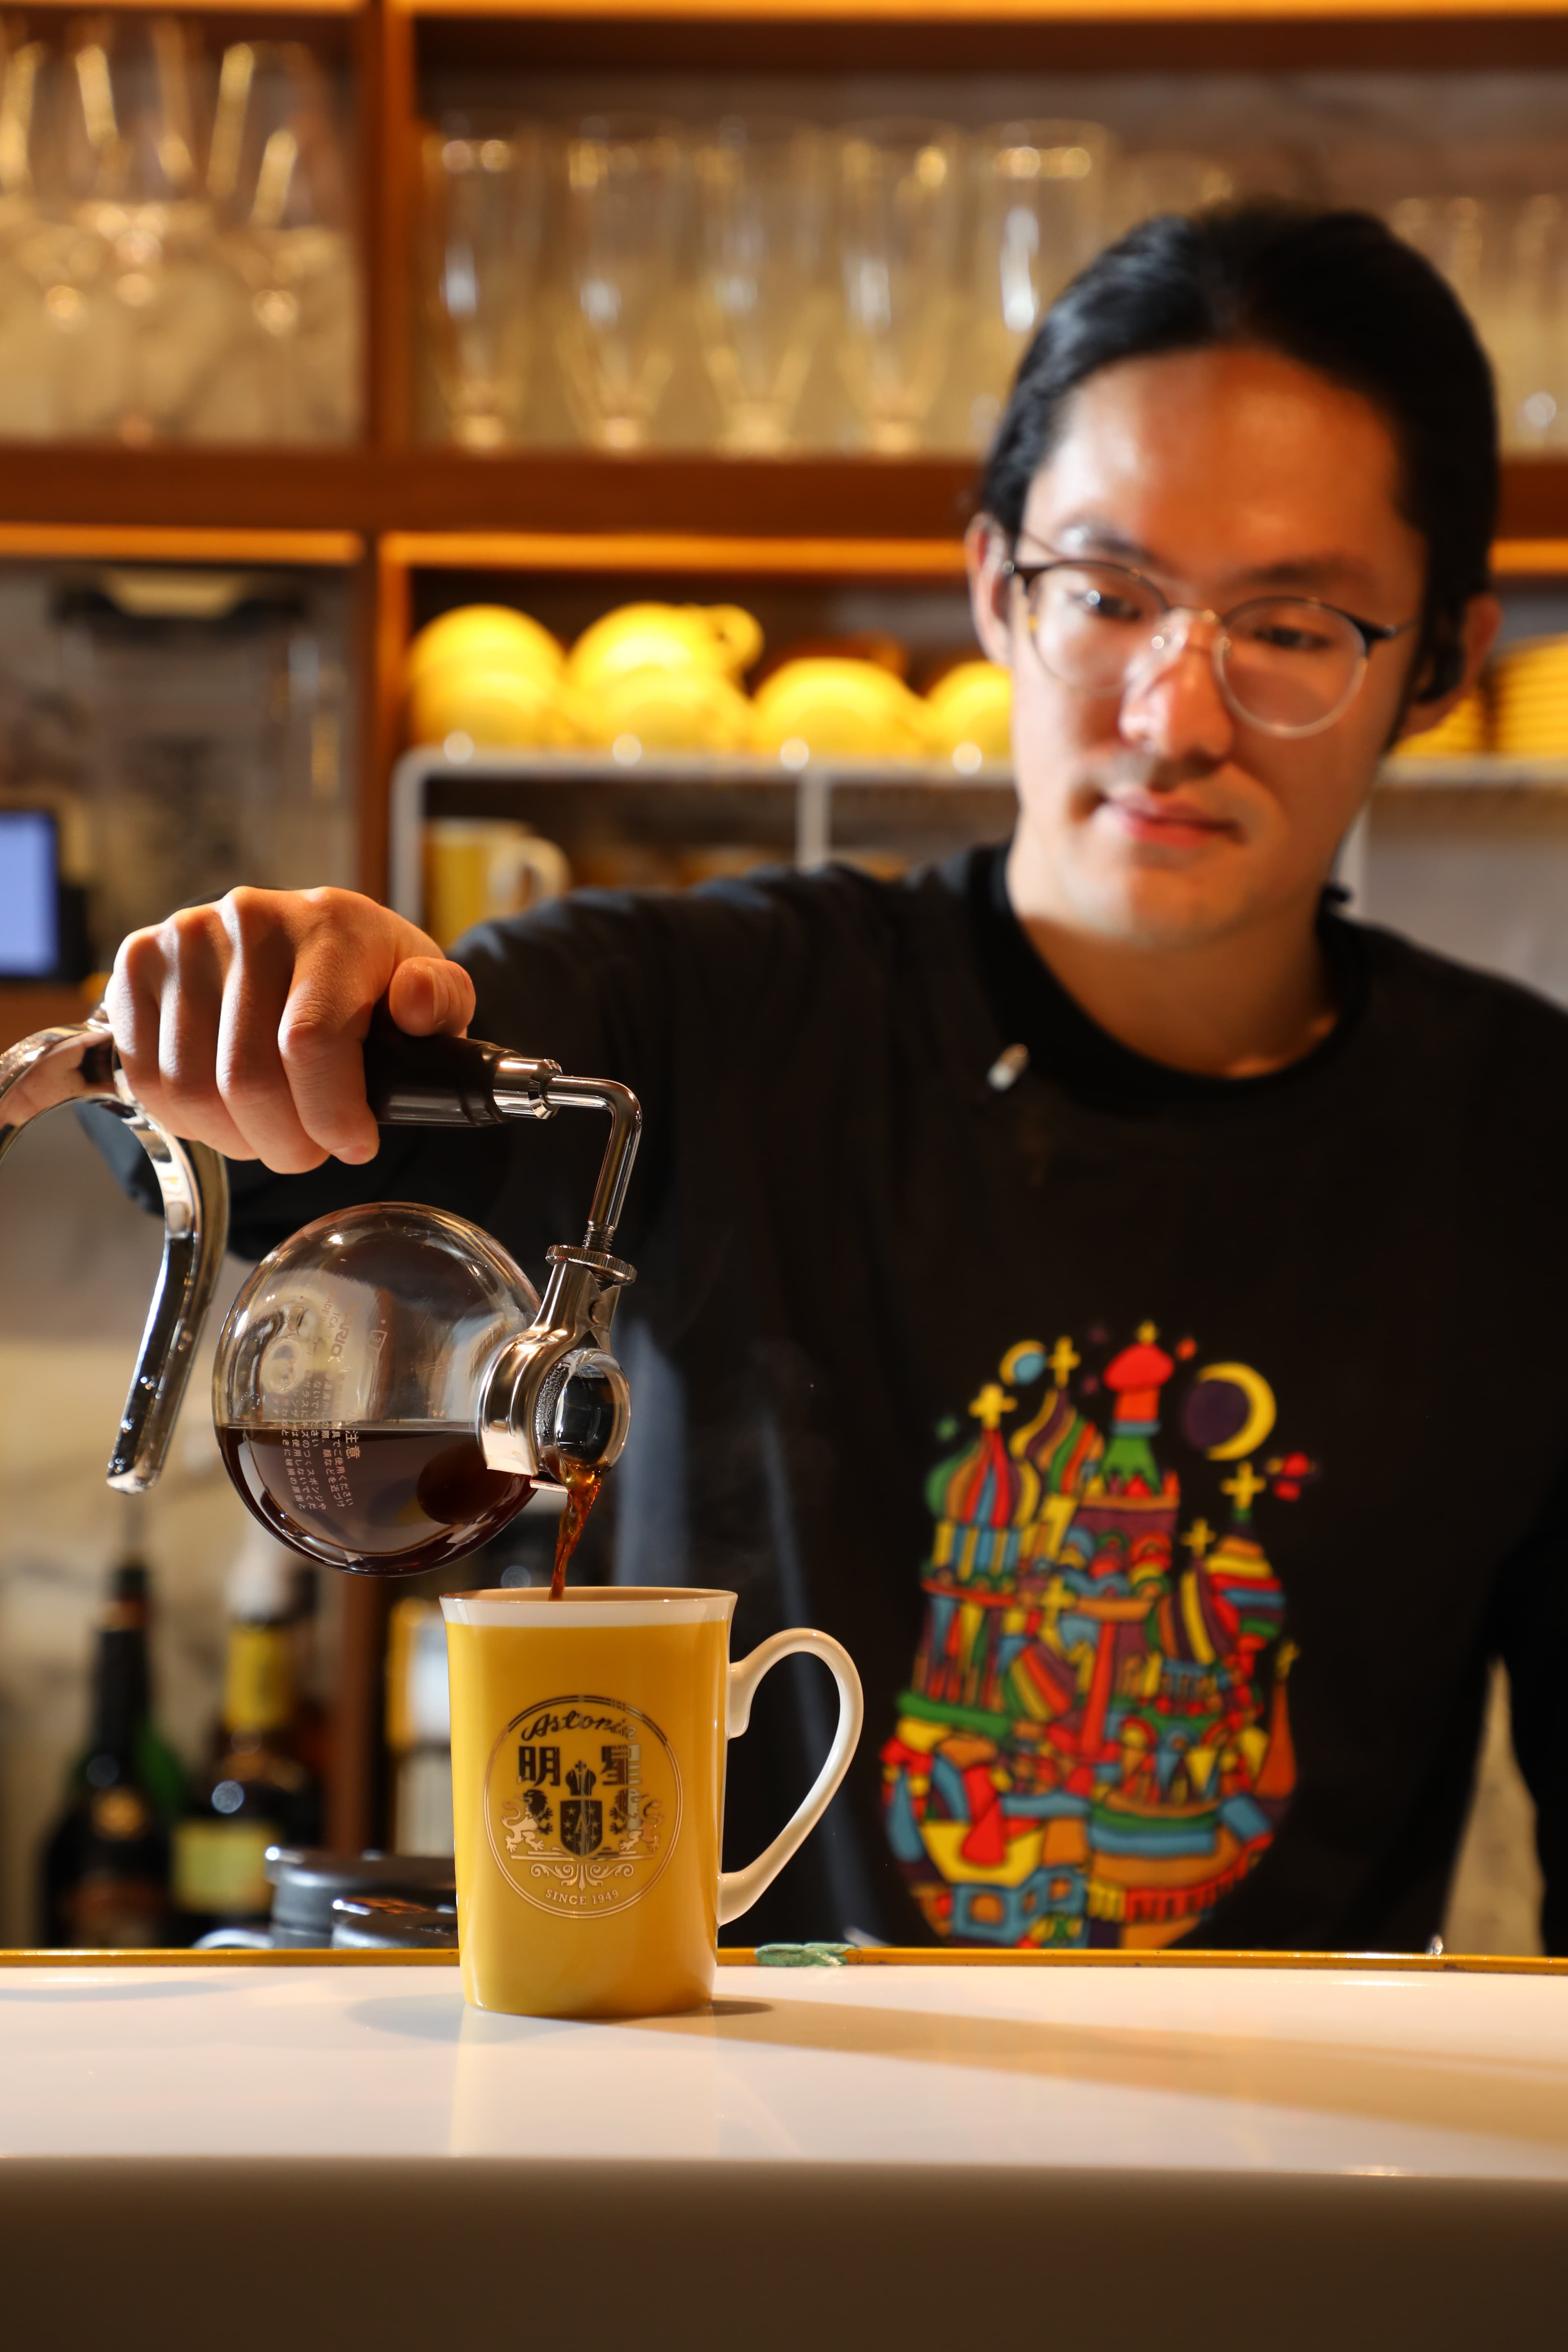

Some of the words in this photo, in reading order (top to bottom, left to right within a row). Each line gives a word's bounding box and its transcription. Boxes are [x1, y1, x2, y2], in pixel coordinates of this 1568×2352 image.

[345, 1430, 361, 1459] 注意
[575, 1812, 589, 1834] A
[545, 1889, 586, 1905] SINCE
[591, 1889, 619, 1904] 1949
